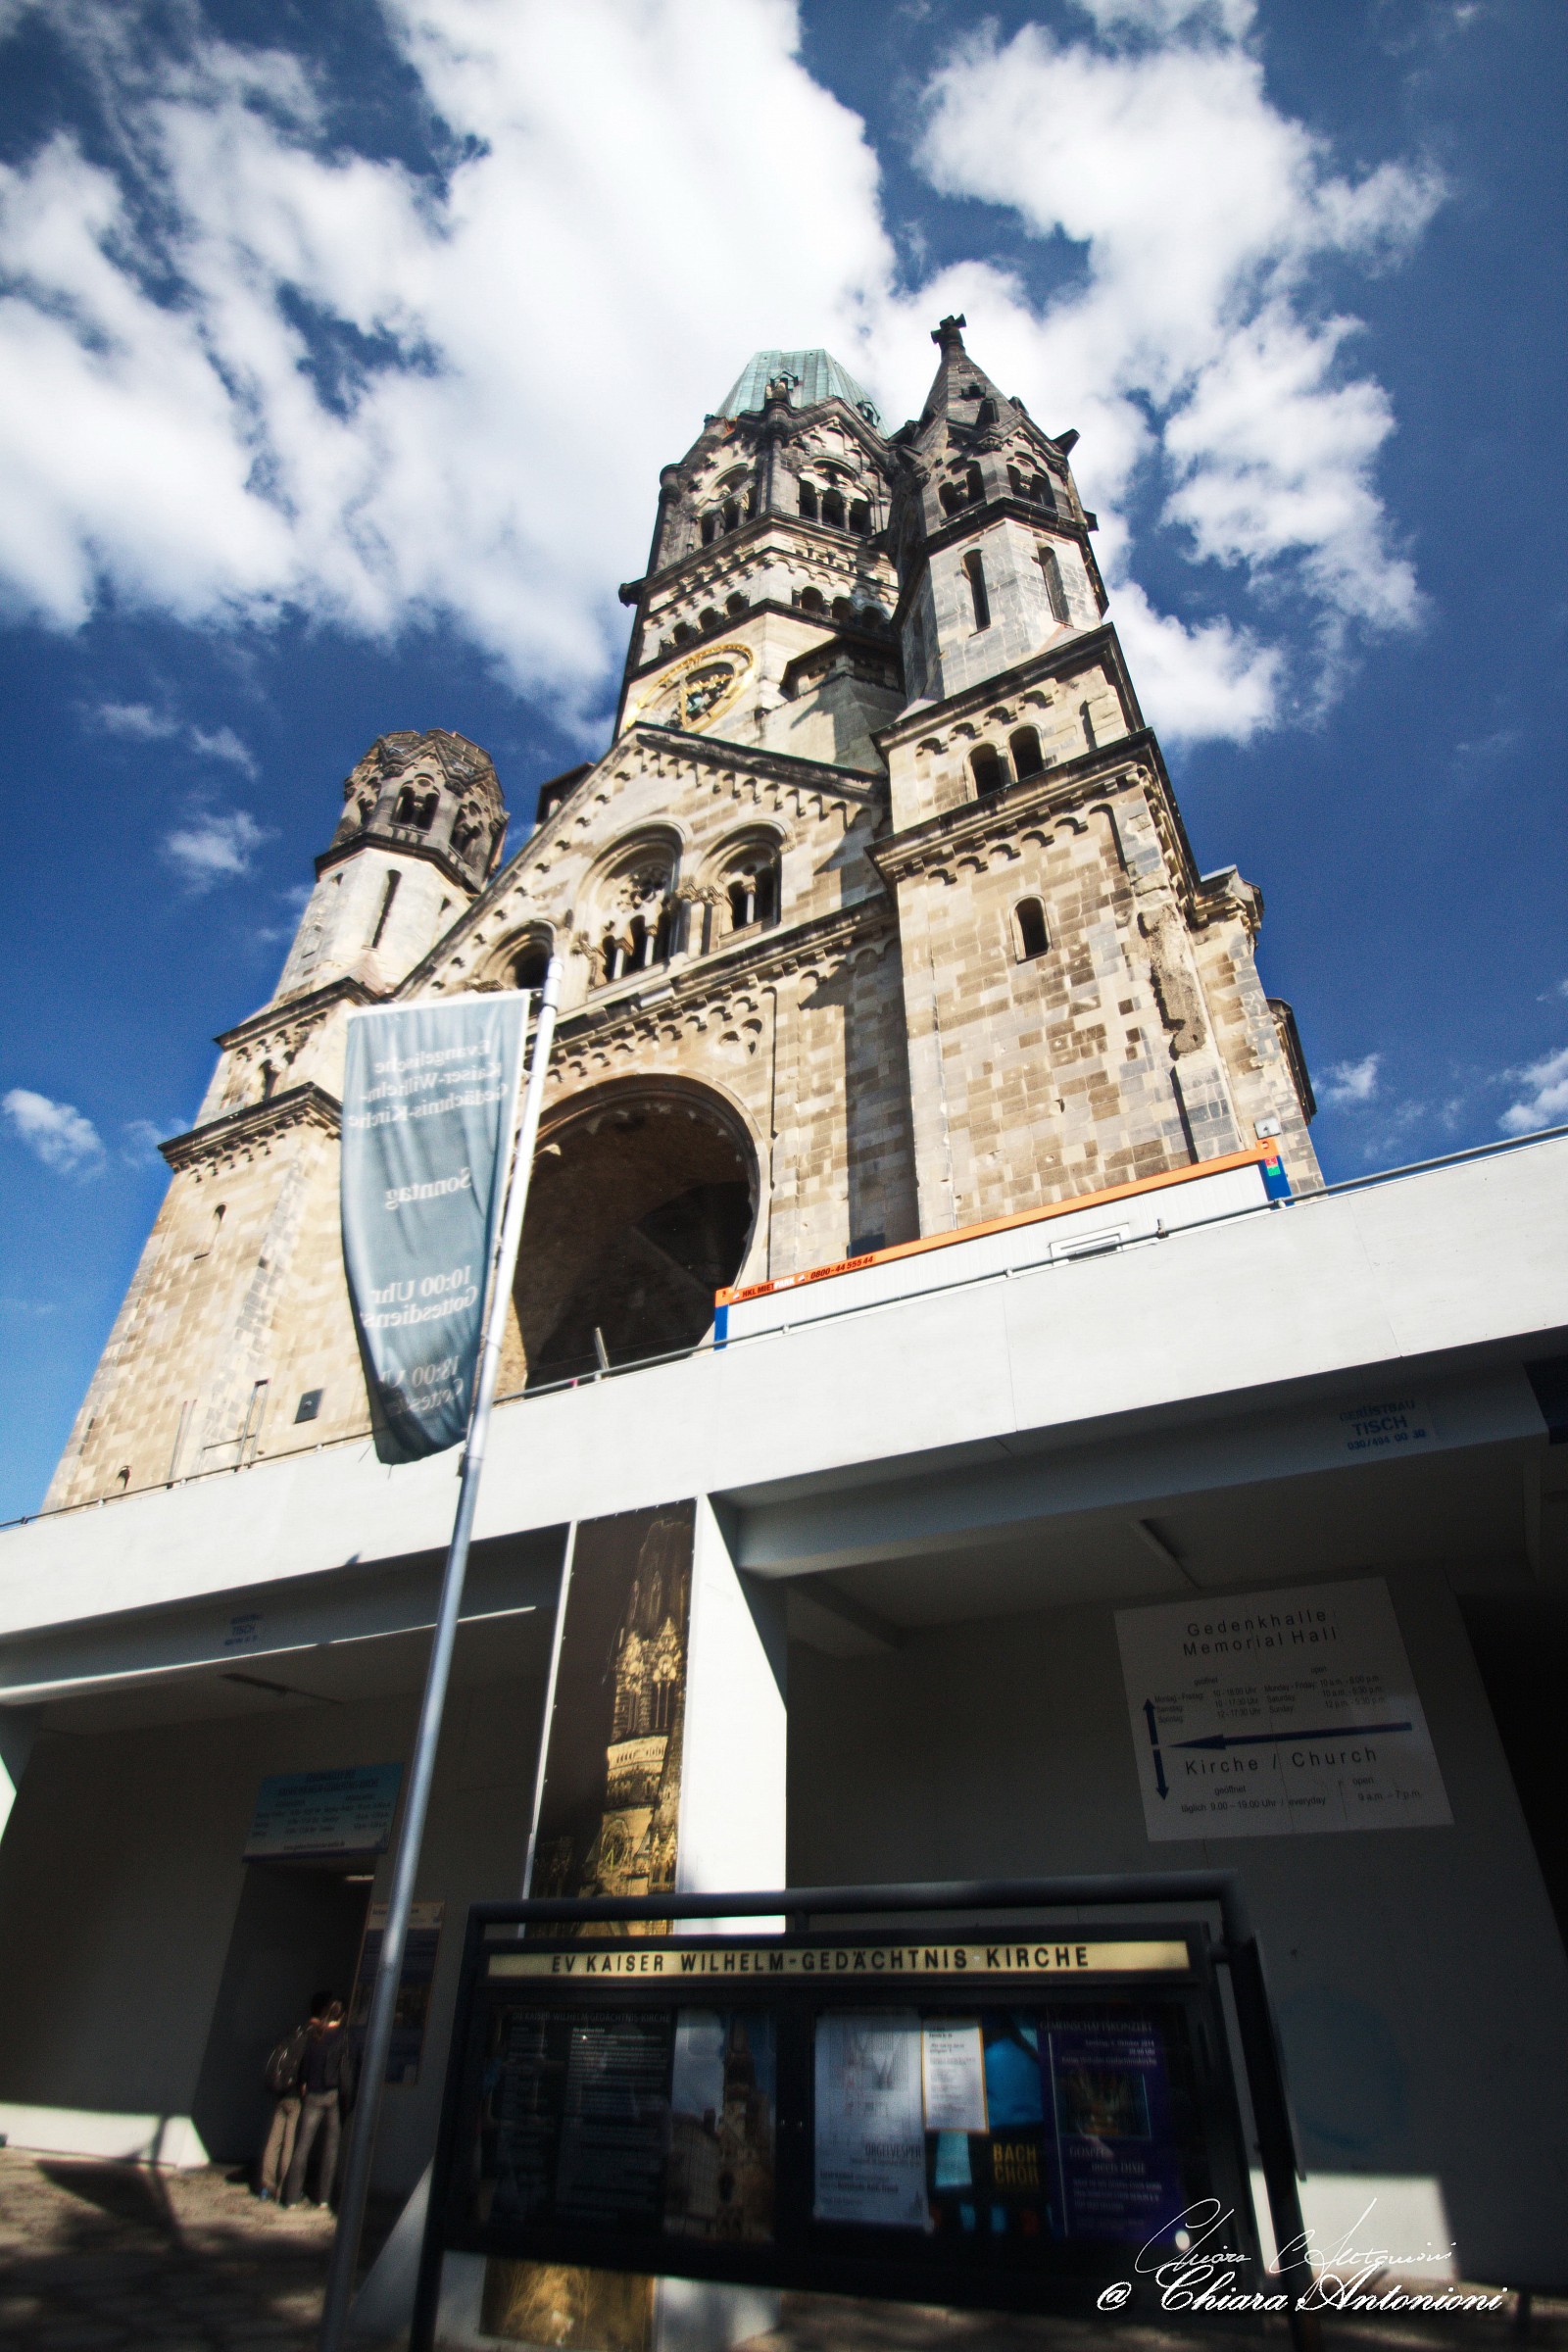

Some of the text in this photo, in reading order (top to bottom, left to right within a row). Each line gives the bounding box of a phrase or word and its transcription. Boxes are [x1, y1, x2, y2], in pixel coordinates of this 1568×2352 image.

[742, 1289, 757, 1298] HKL
[1350, 1414, 1408, 1437] TISCH
[1187, 1608, 1327, 1638] Gedenkhalle
[1183, 1626, 1338, 1657] Memorial Hall
[1185, 1756, 1258, 1775] Kirche
[1292, 1746, 1377, 1767] Church
[1214, 1785, 1247, 1796] geöffnet
[1351, 1776, 1375, 1787] open
[1181, 1802, 1207, 1814] täglich
[1261, 1798, 1276, 1807] Uhr
[1288, 1795, 1326, 1806] everyday
[551, 1945, 1090, 1973] EV KAISER WILHELM-GEDÄCHTNIS KIRCHE
[993, 2142, 1038, 2163] BACH
[994, 2164, 1040, 2185] CHOR
